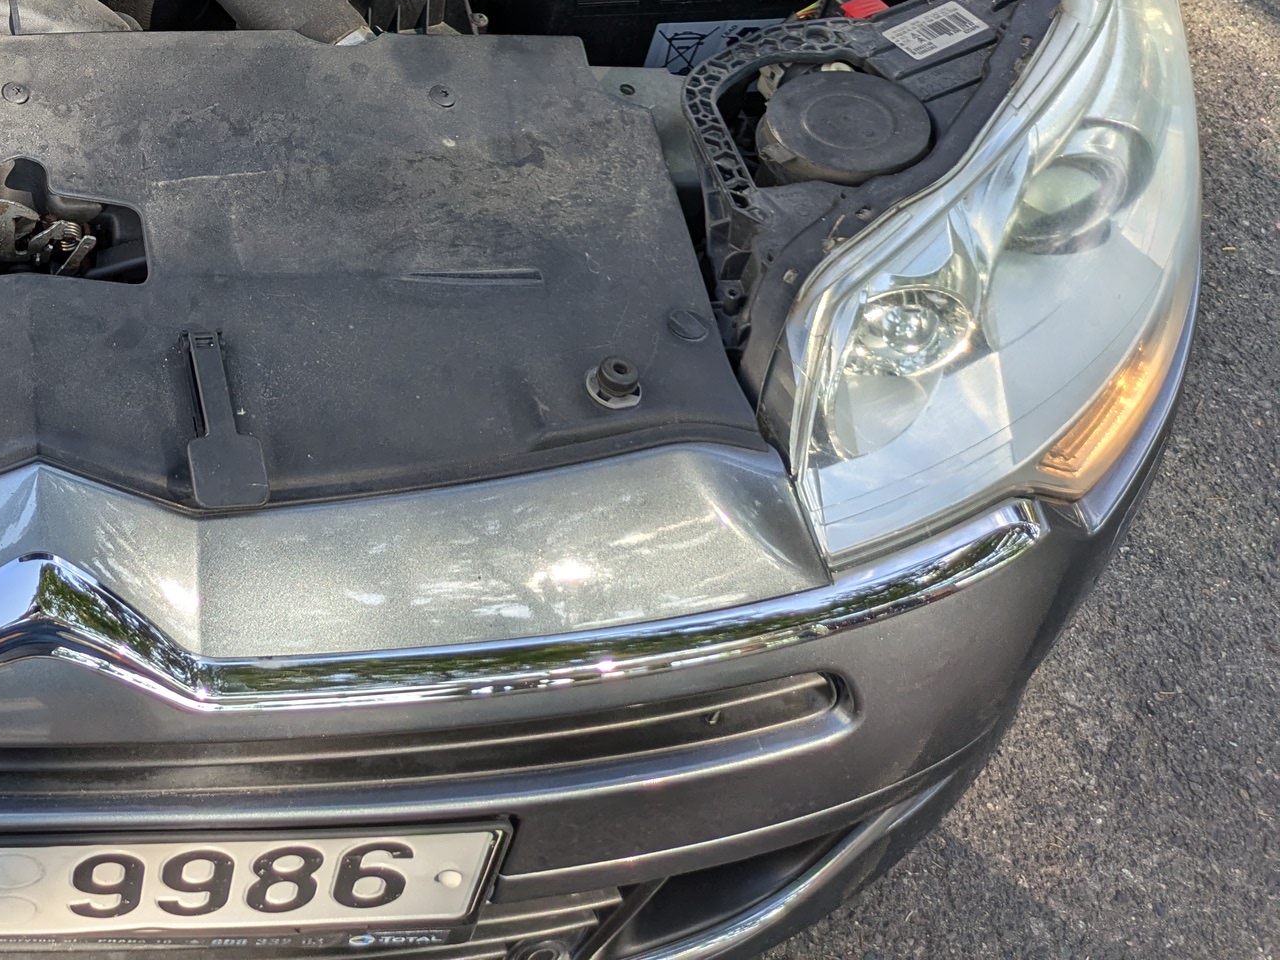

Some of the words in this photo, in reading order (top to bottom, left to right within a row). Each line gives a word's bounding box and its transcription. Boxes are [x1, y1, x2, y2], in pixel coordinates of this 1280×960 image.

[721, 24, 738, 38] LEAD
[67, 841, 417, 920] 9986
[378, 935, 443, 944] TOTAL
